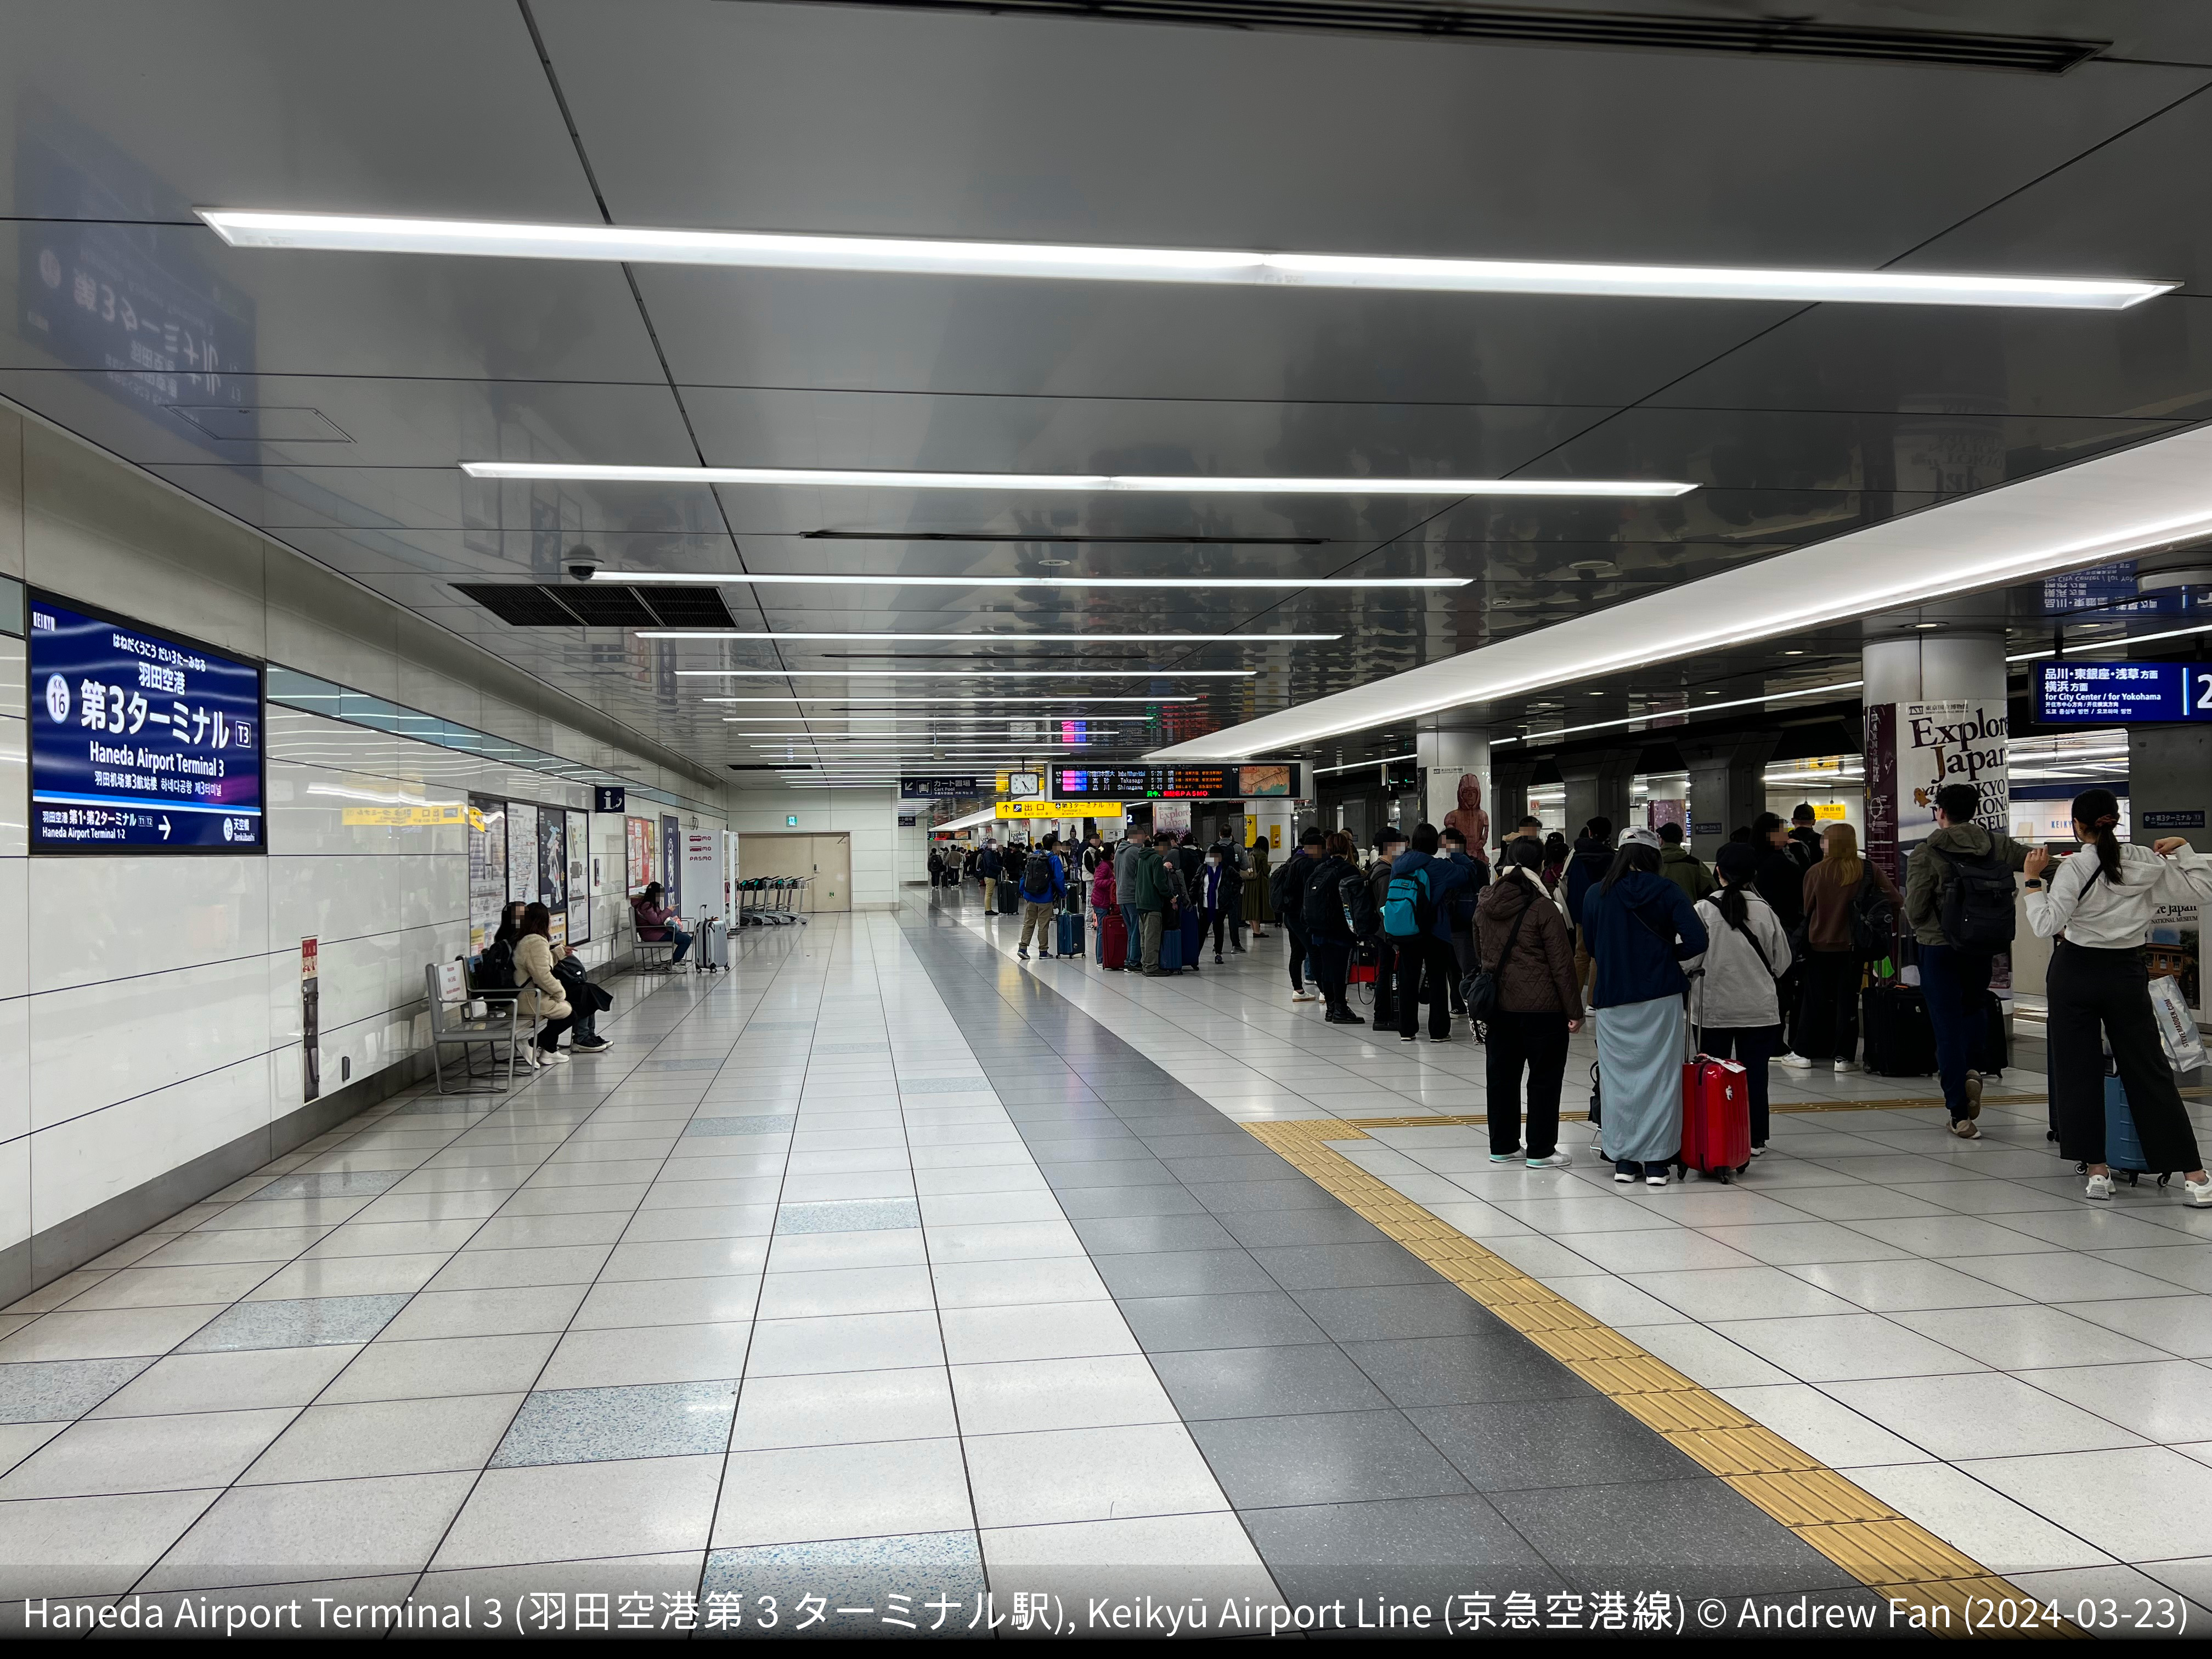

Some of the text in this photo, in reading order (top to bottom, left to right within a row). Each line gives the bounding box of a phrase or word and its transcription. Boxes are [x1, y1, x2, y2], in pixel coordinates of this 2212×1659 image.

[33, 611, 55, 631] KEIKYU
[113, 633, 206, 672] はねだくうこう だい3たーみなる
[139, 661, 185, 695] 羽田空港
[2045, 668, 2158, 680] 品川・東銀座・浅草 方面
[2045, 681, 2089, 692] 横浜 方面
[2197, 674, 2212, 708] 2
[52, 692, 65, 714] 16
[2058, 693, 2074, 702] City
[81, 679, 229, 749] 第3ターミナル
[238, 725, 249, 744] T3
[90, 741, 225, 777] Haneda Airport Terminal 3
[161, 777, 193, 794] 하네다공항
[42, 811, 67, 823] 羽田空港
[1127, 814, 1133, 822] 2
[1159, 808, 1188, 821] Explore
[42, 826, 67, 838] Haneda
[68, 827, 90, 840] Airport
[91, 828, 116, 839] Terminal
